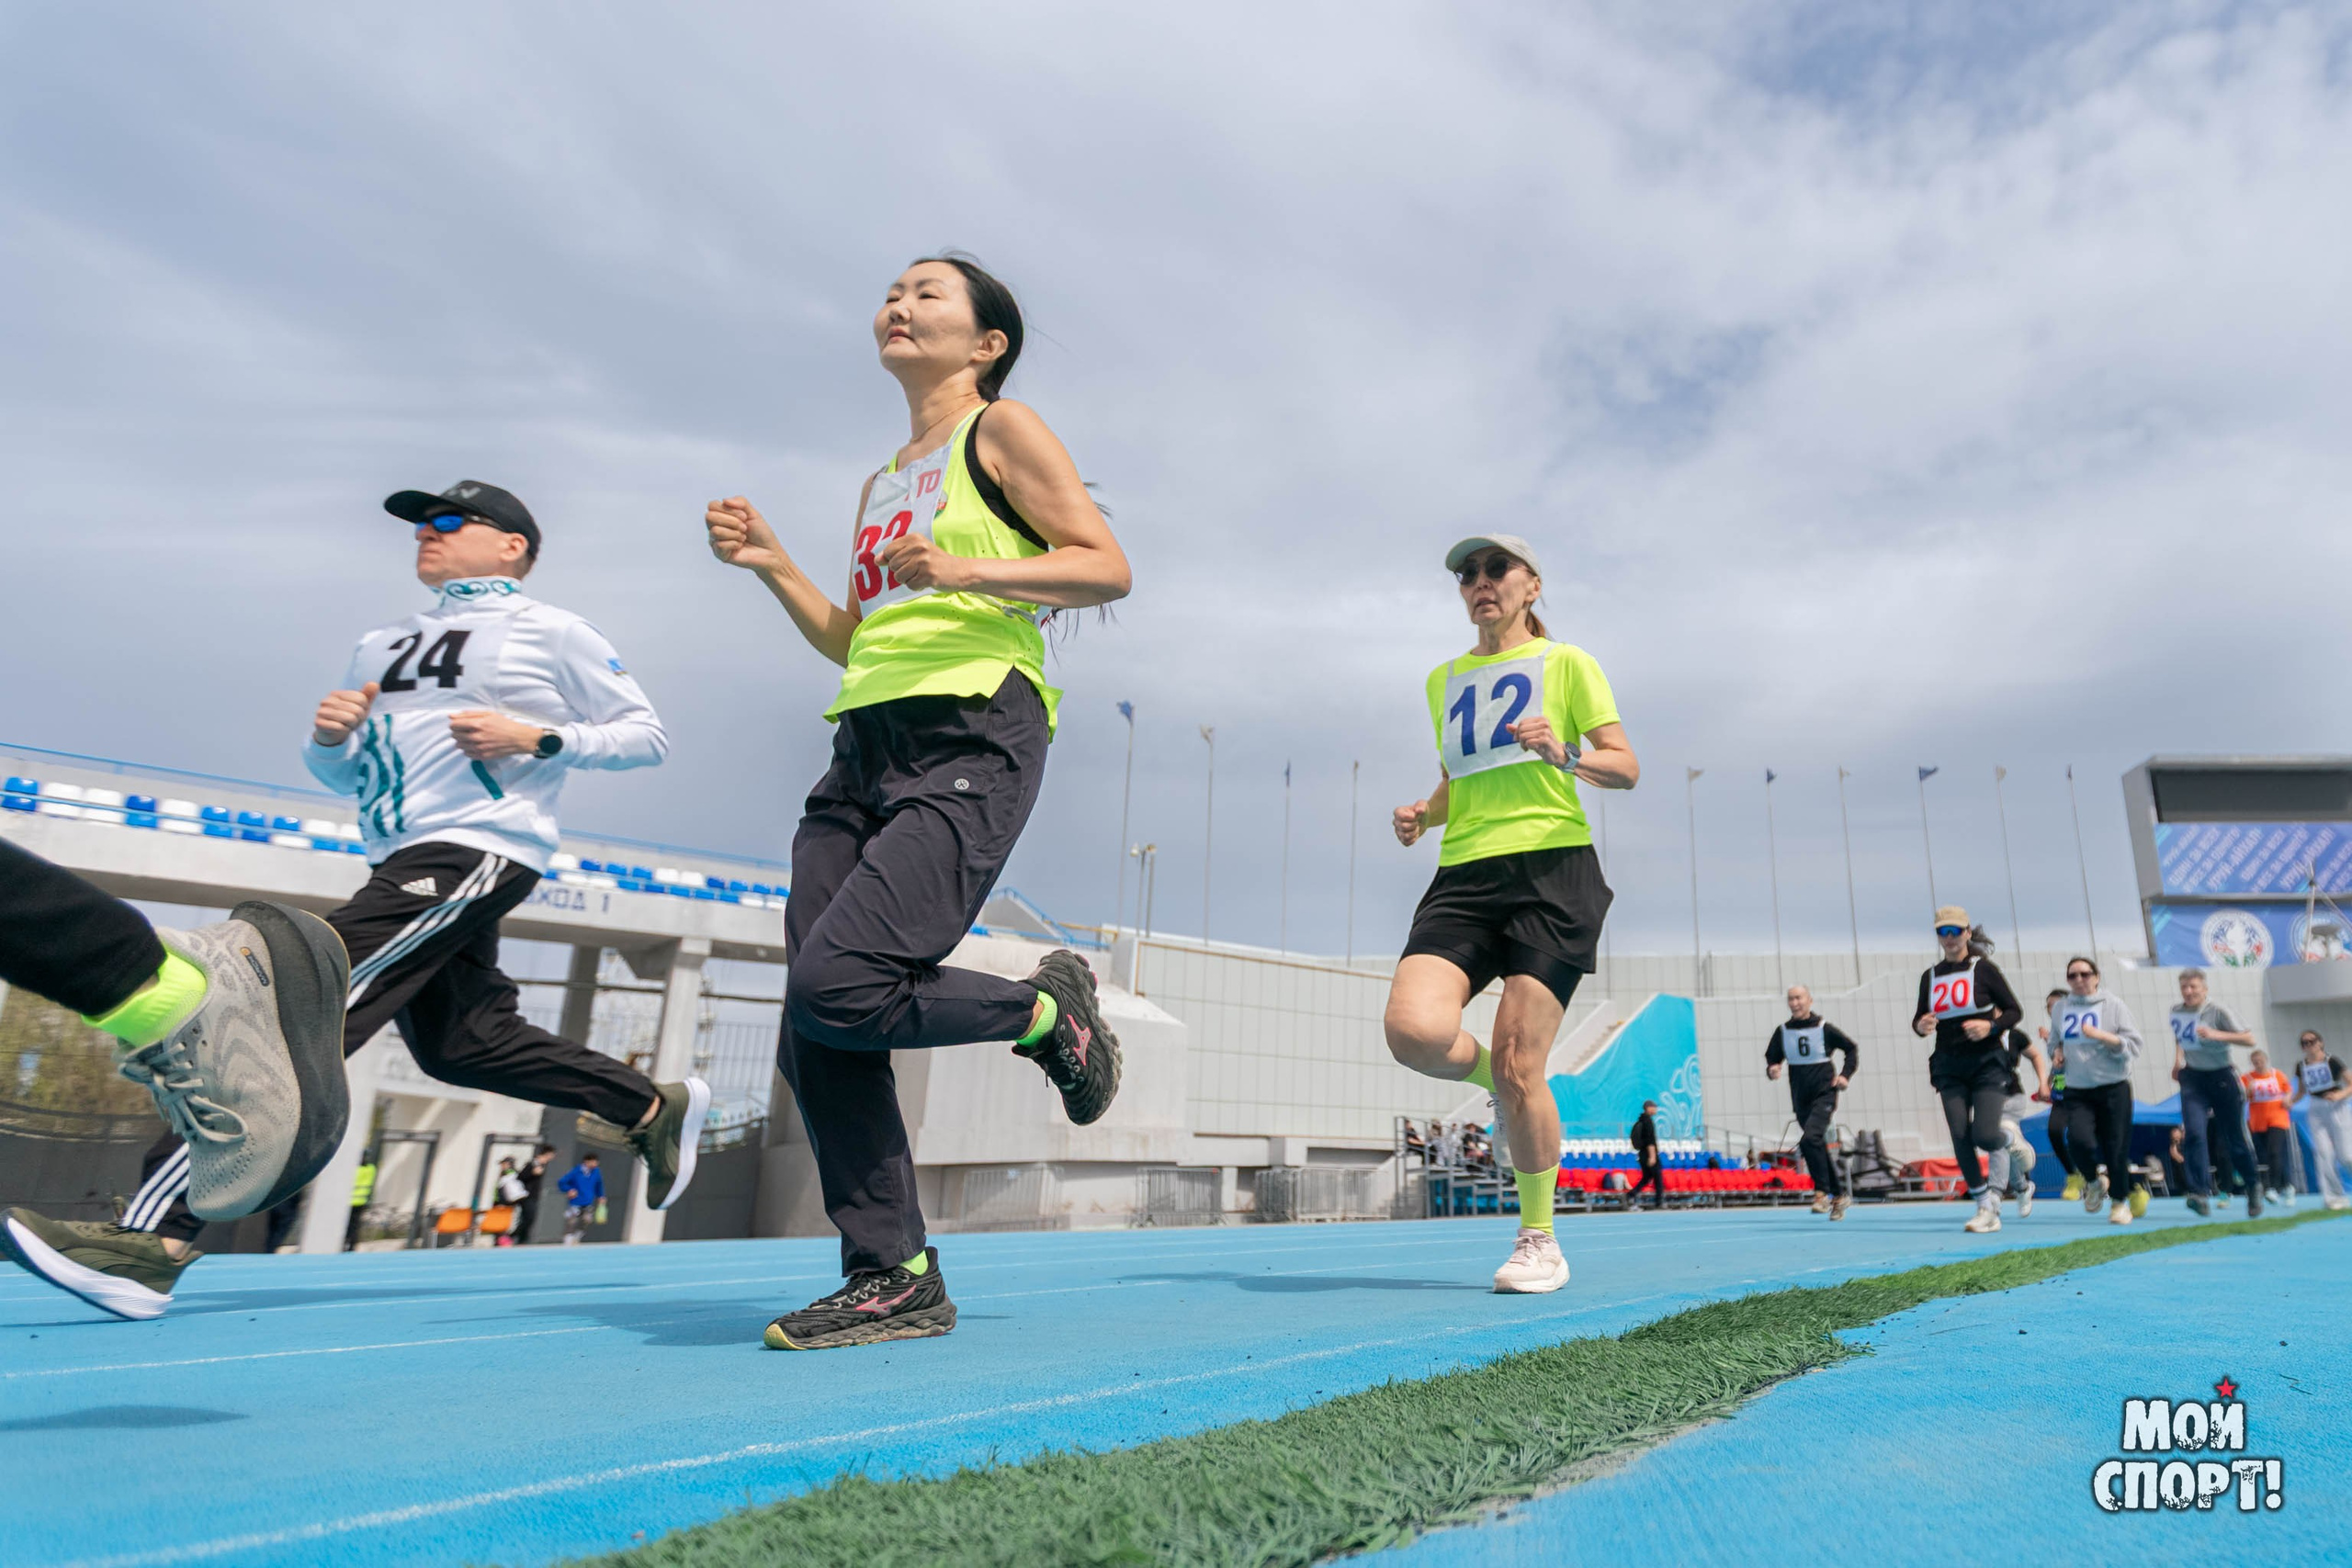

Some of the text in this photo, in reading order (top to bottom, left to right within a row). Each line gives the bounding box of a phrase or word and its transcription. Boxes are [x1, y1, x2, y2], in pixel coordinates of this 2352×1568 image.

[379, 630, 473, 694] 24
[1449, 672, 1532, 757] 12
[601, 893, 610, 914] 1
[1933, 977, 1971, 1014] 20
[2064, 1011, 2099, 1039] 20
[2170, 1018, 2197, 1043] 24
[1797, 1035, 1811, 1056] 6
